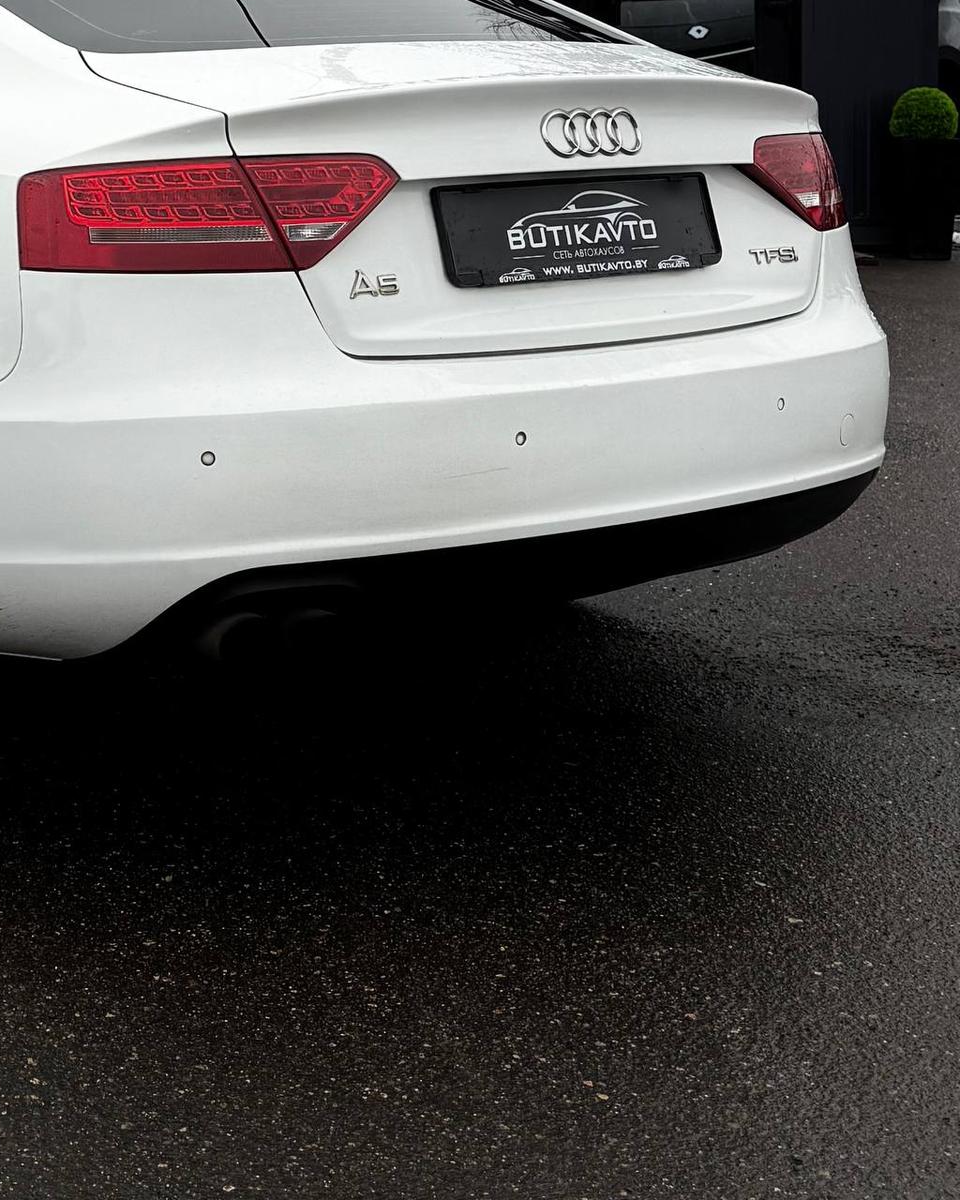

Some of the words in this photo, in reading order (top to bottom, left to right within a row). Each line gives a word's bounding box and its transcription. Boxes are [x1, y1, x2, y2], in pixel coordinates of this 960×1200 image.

[507, 218, 658, 250] BUTIKAVTO
[553, 249, 572, 260] СЕТЬ
[574, 246, 625, 258] АВТОХАУСОВ
[576, 259, 649, 273] BUTIKAVTO.BY
[349, 269, 400, 300] A5
